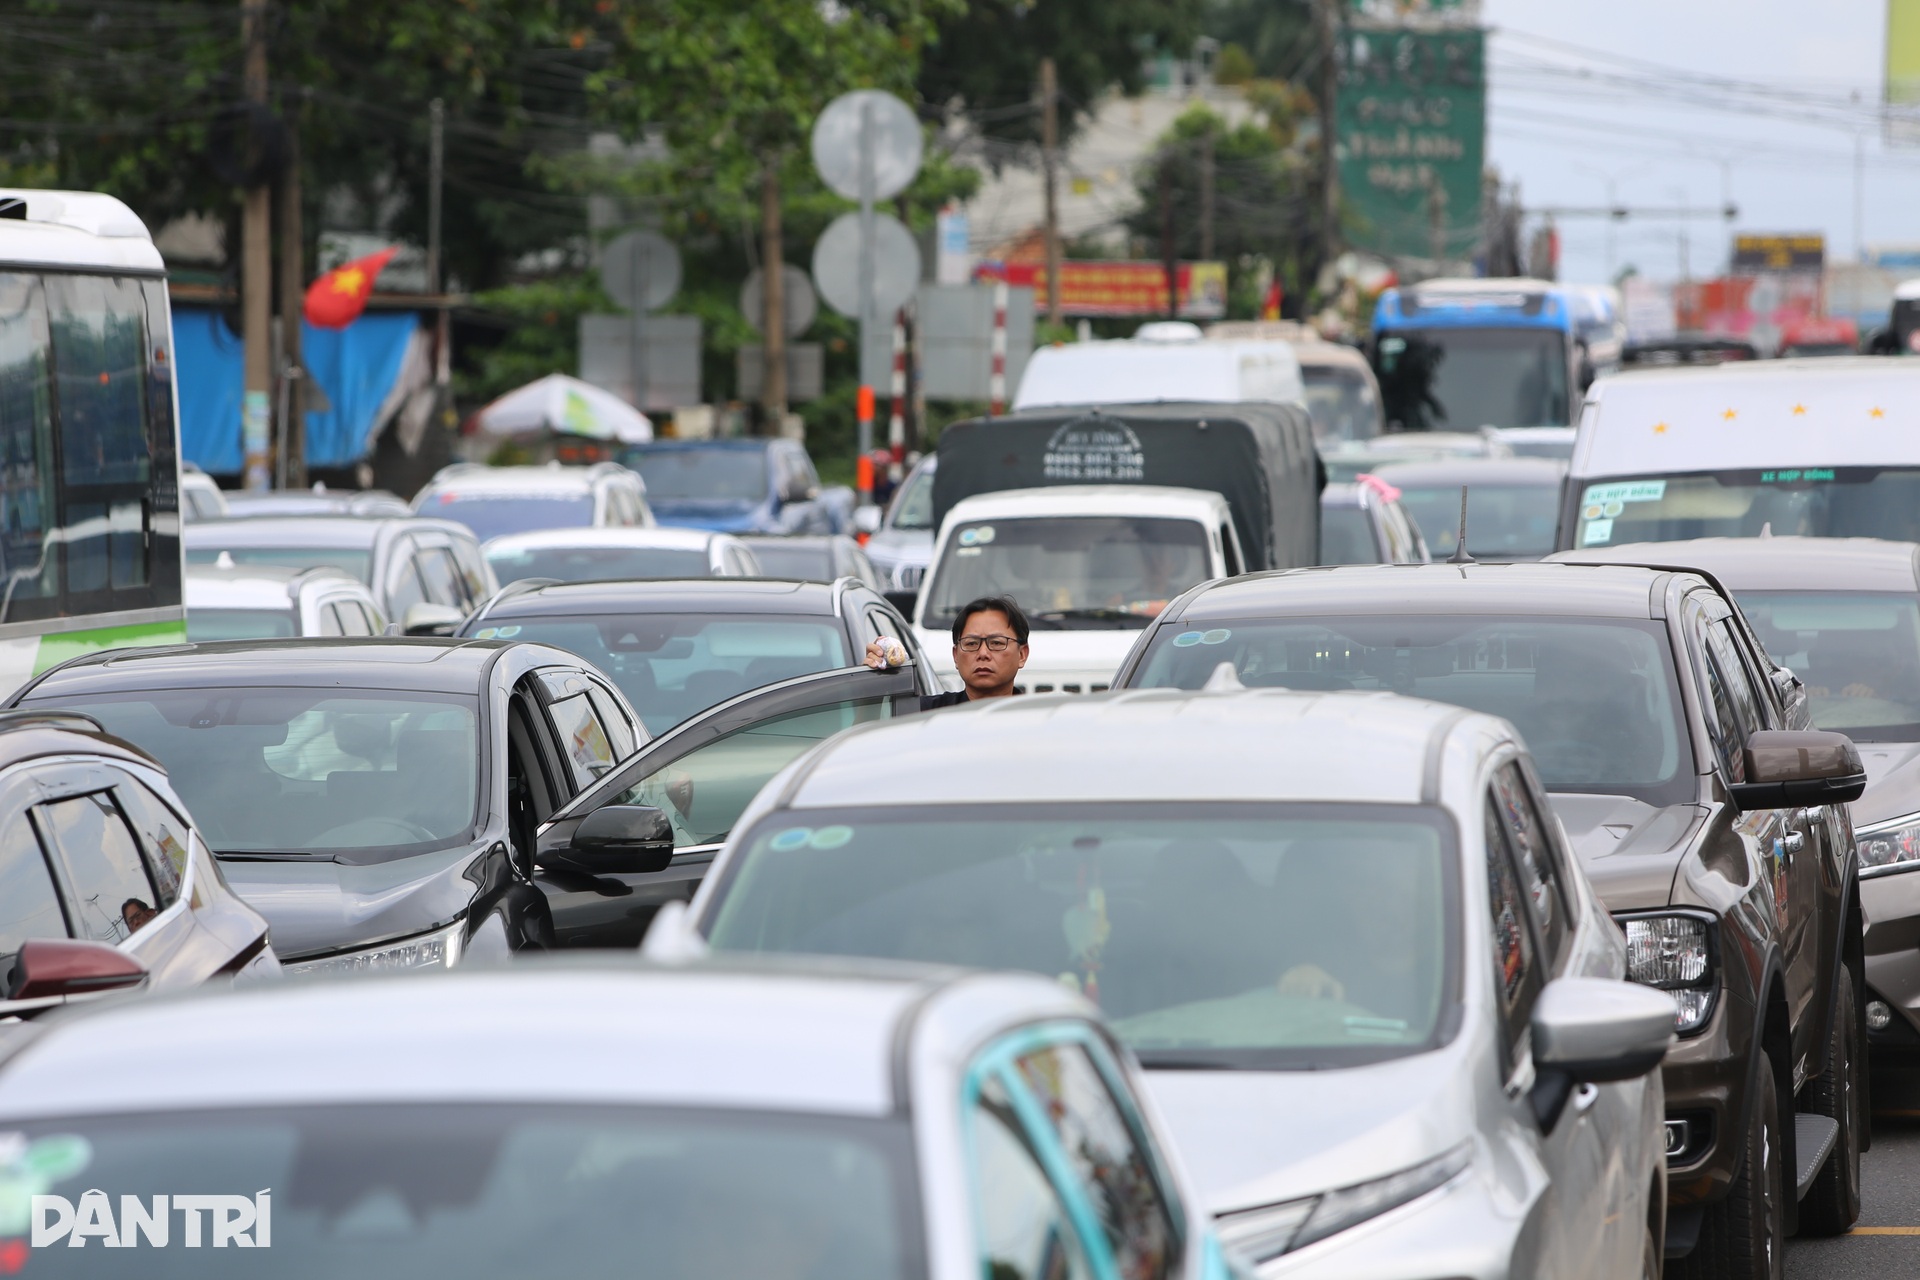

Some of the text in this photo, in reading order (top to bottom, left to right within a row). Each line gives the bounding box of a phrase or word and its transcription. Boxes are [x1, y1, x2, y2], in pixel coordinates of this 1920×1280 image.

[1761, 467, 1834, 482] XE HỢP ĐỒNG
